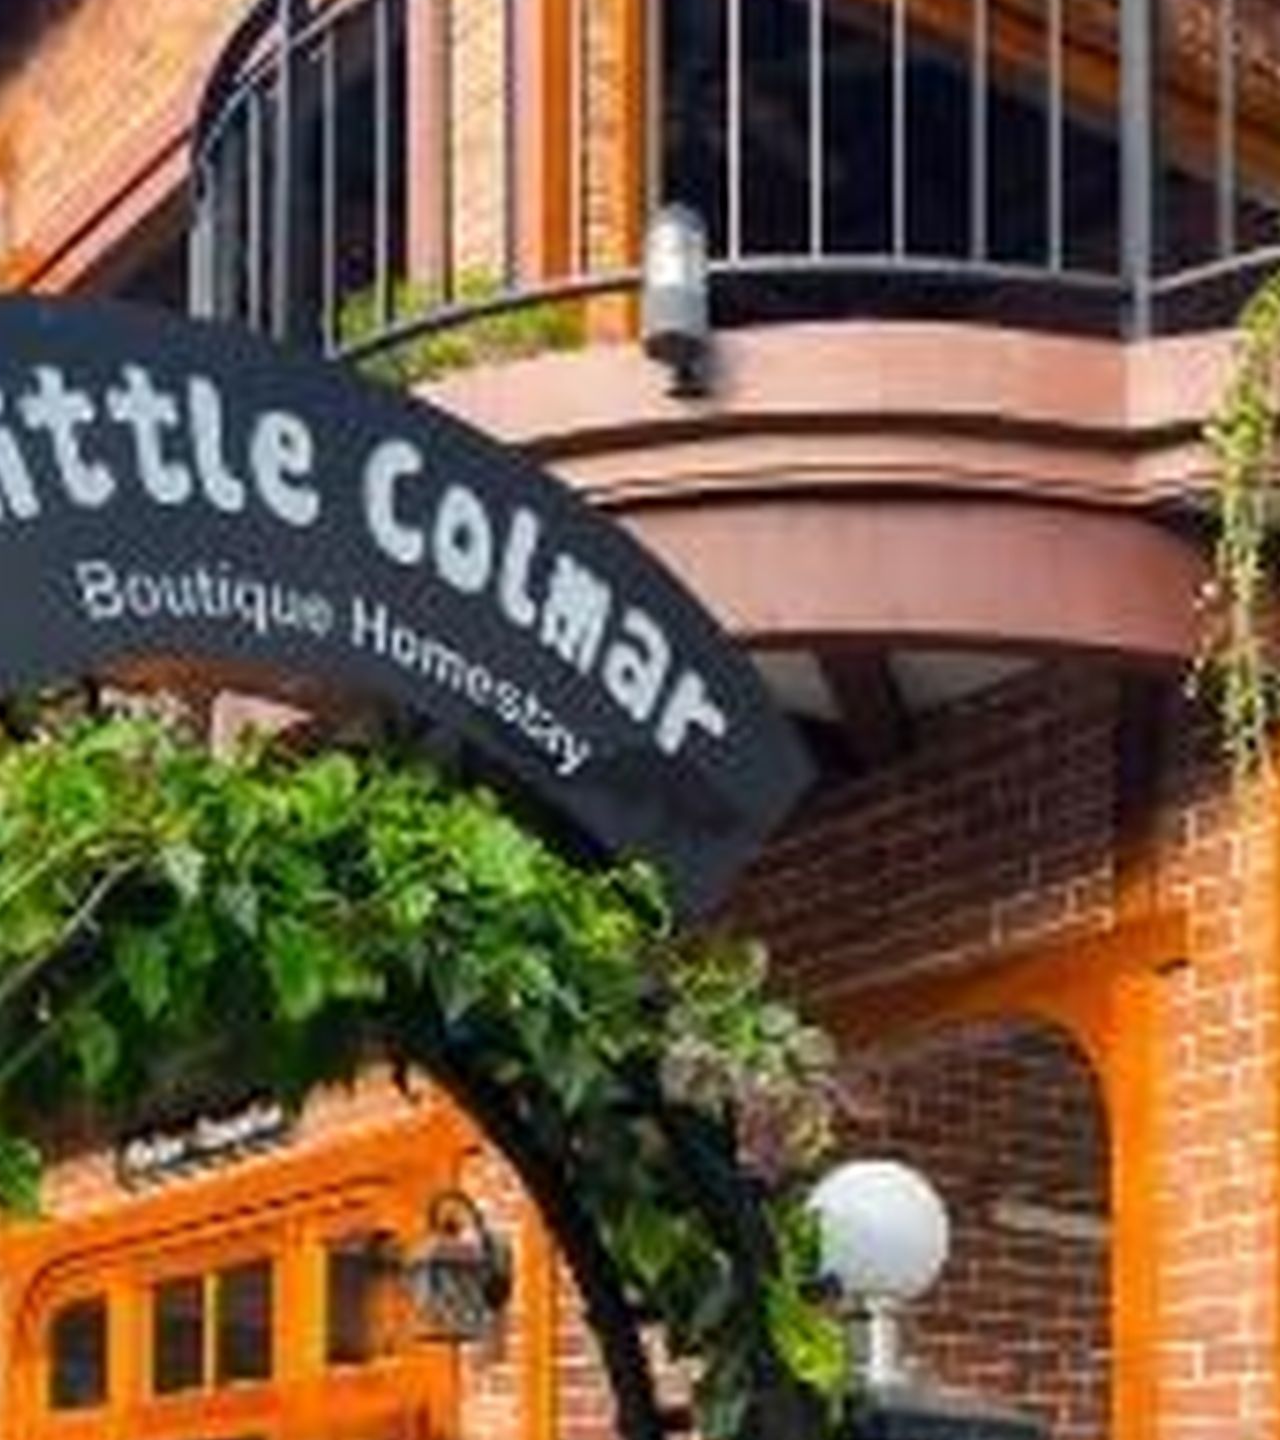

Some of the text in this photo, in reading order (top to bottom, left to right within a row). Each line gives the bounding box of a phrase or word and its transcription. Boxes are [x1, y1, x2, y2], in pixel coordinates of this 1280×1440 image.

[75, 560, 590, 776] Boutique Homestay
[364, 440, 726, 753] Colmar
